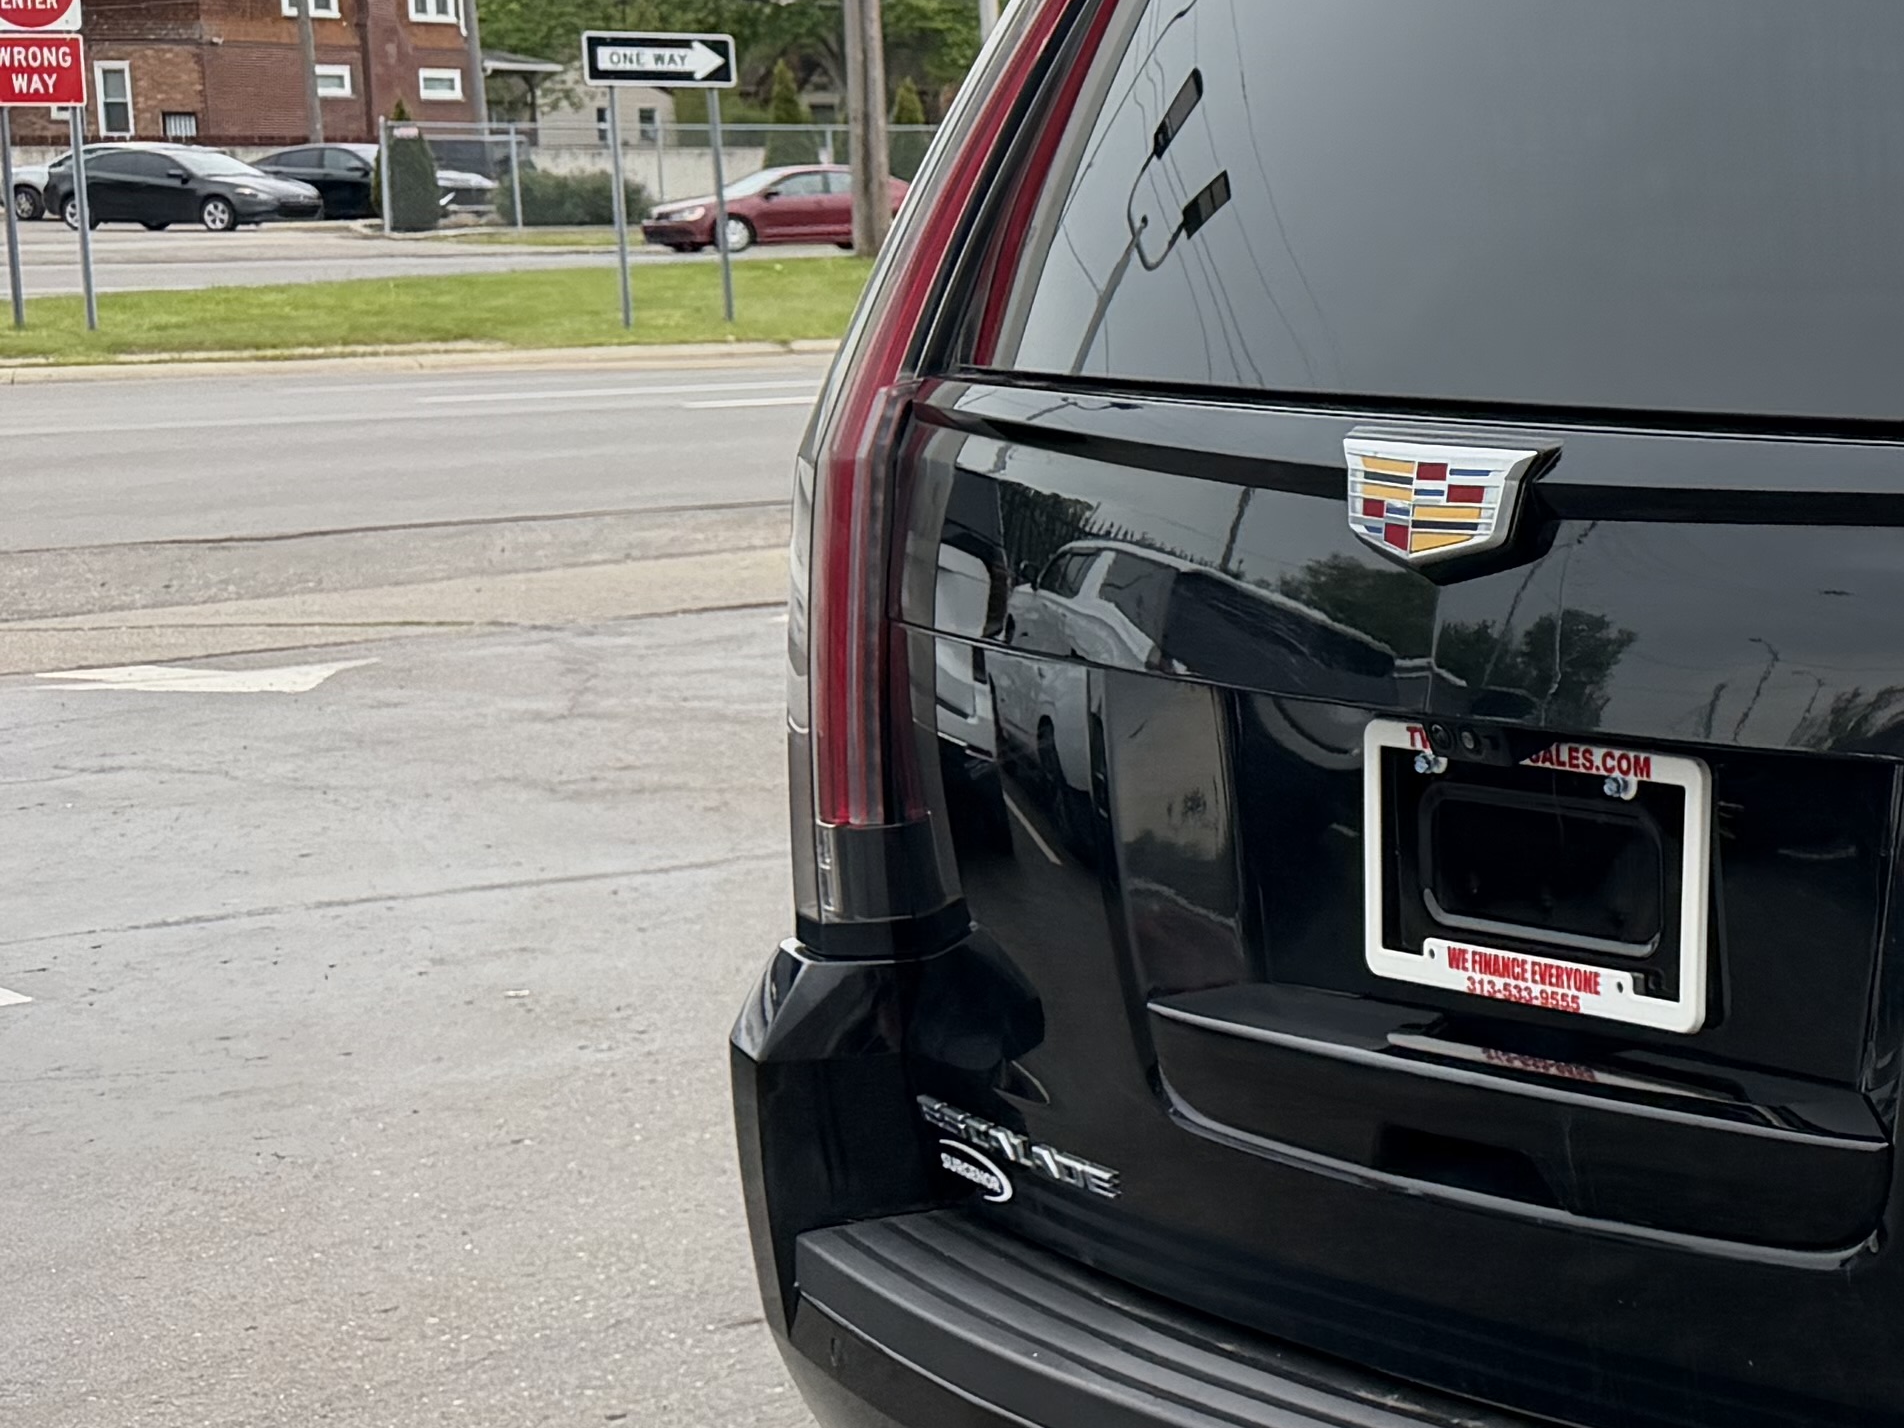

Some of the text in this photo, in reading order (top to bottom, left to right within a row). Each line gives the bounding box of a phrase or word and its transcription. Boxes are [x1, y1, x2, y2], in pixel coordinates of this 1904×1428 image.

[609, 51, 688, 67] ONE WAY
[12, 73, 57, 94] WAY
[1447, 945, 1601, 996] WE FINANCE EVERYONE
[1466, 976, 1581, 1013] 313-533-9555
